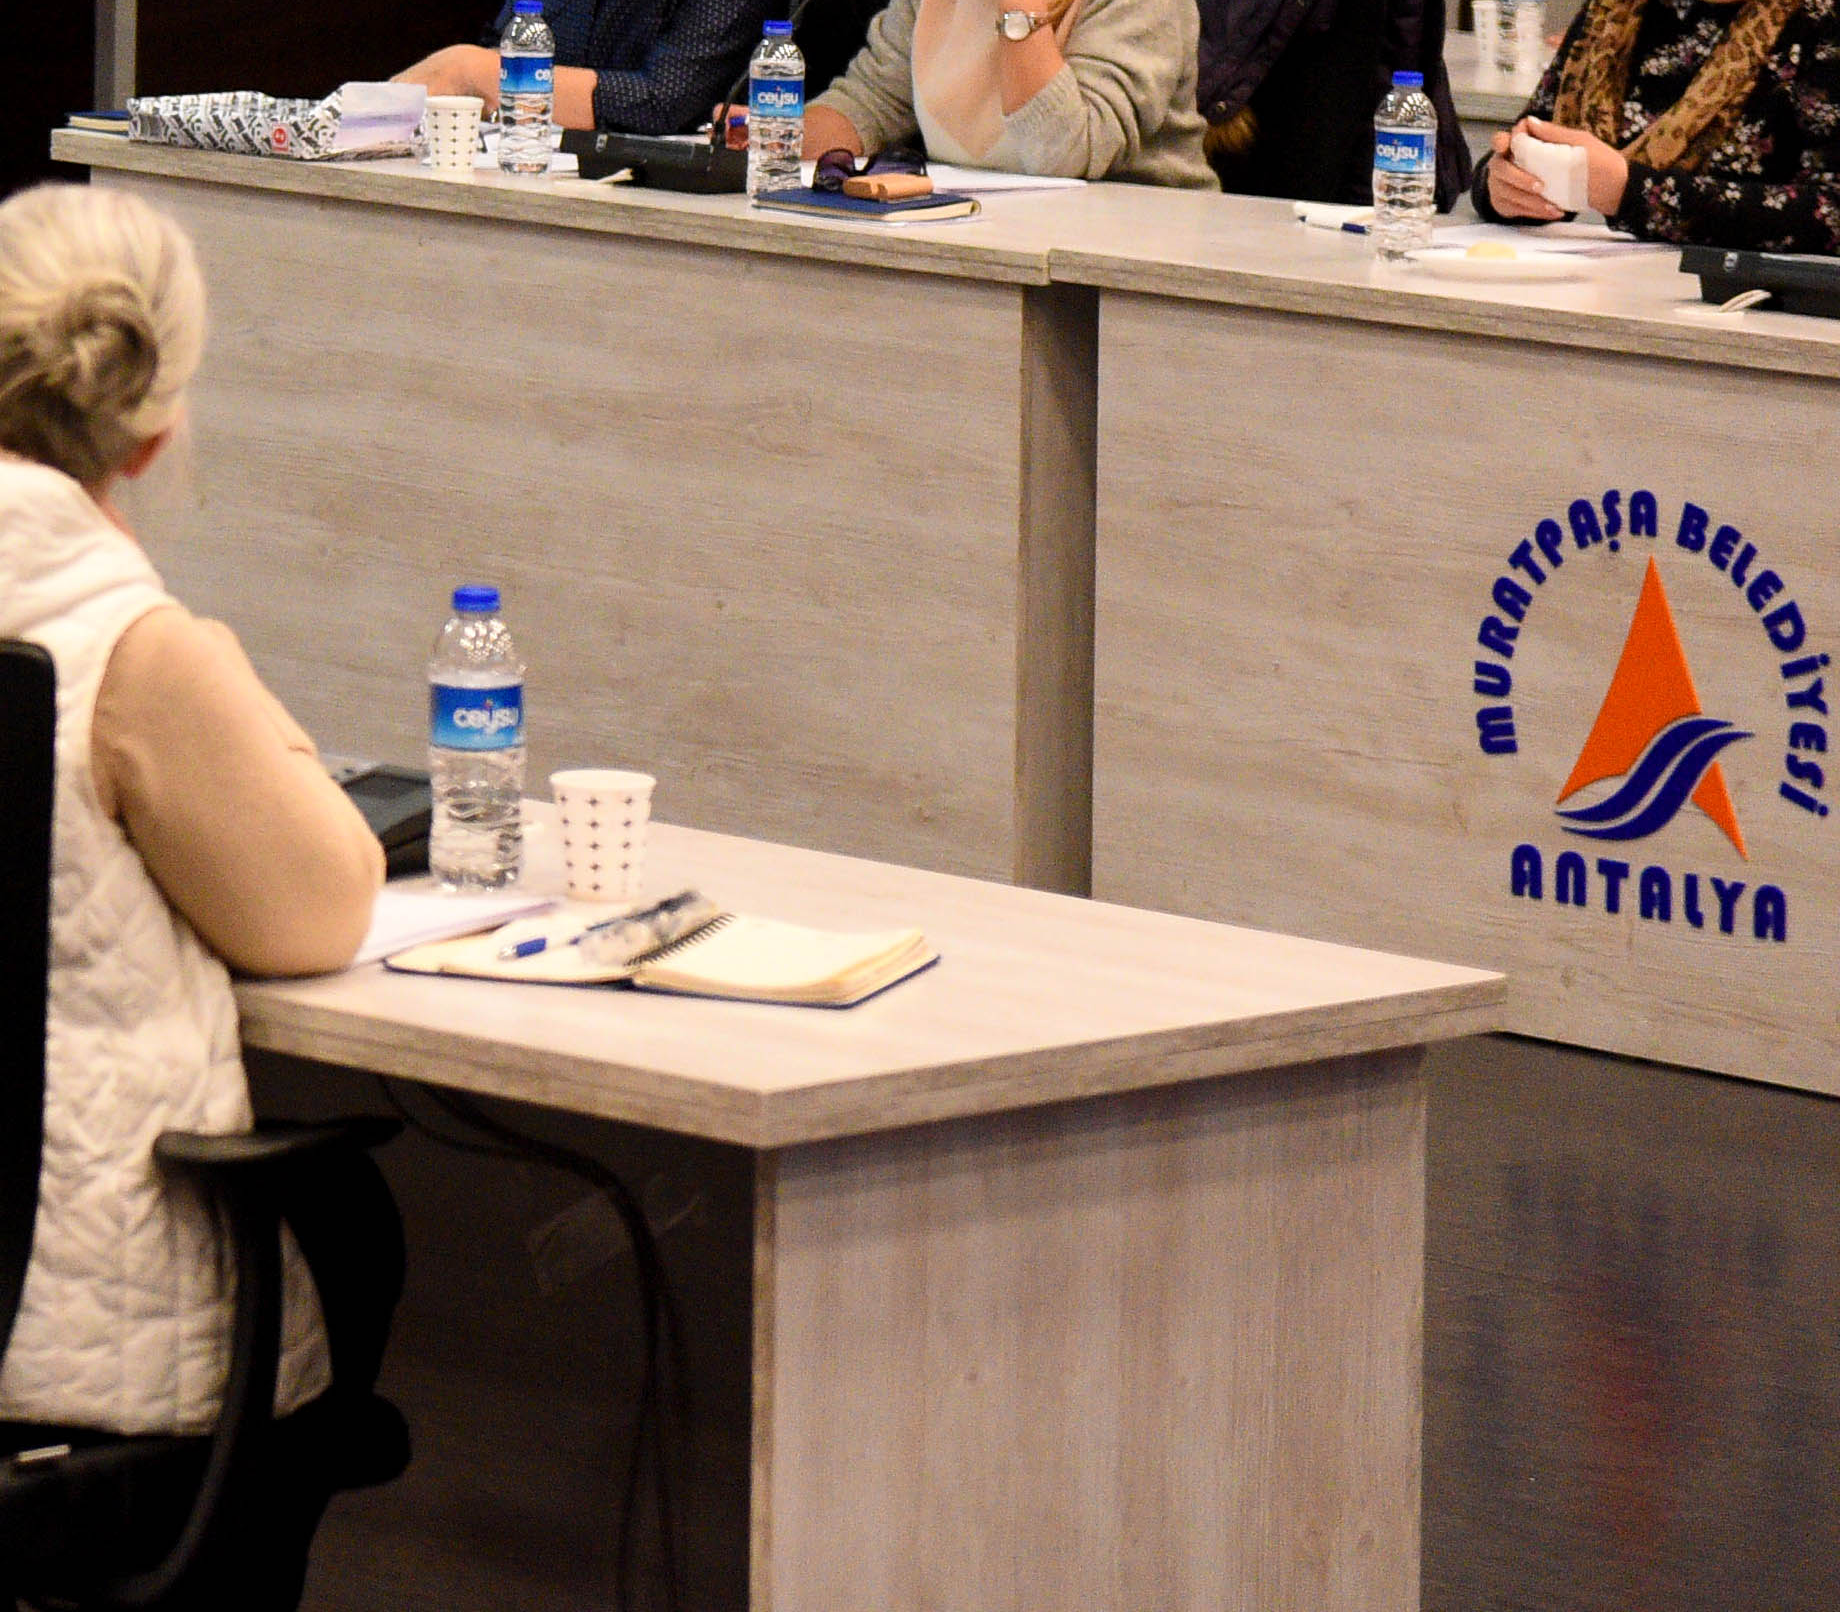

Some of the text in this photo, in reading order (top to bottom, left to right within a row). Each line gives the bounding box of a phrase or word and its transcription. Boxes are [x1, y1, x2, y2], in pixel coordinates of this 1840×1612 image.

[1474, 489, 1830, 817] MURATPAŞA BELEDİYESİ
[1511, 843, 1787, 942] ANTALYA
